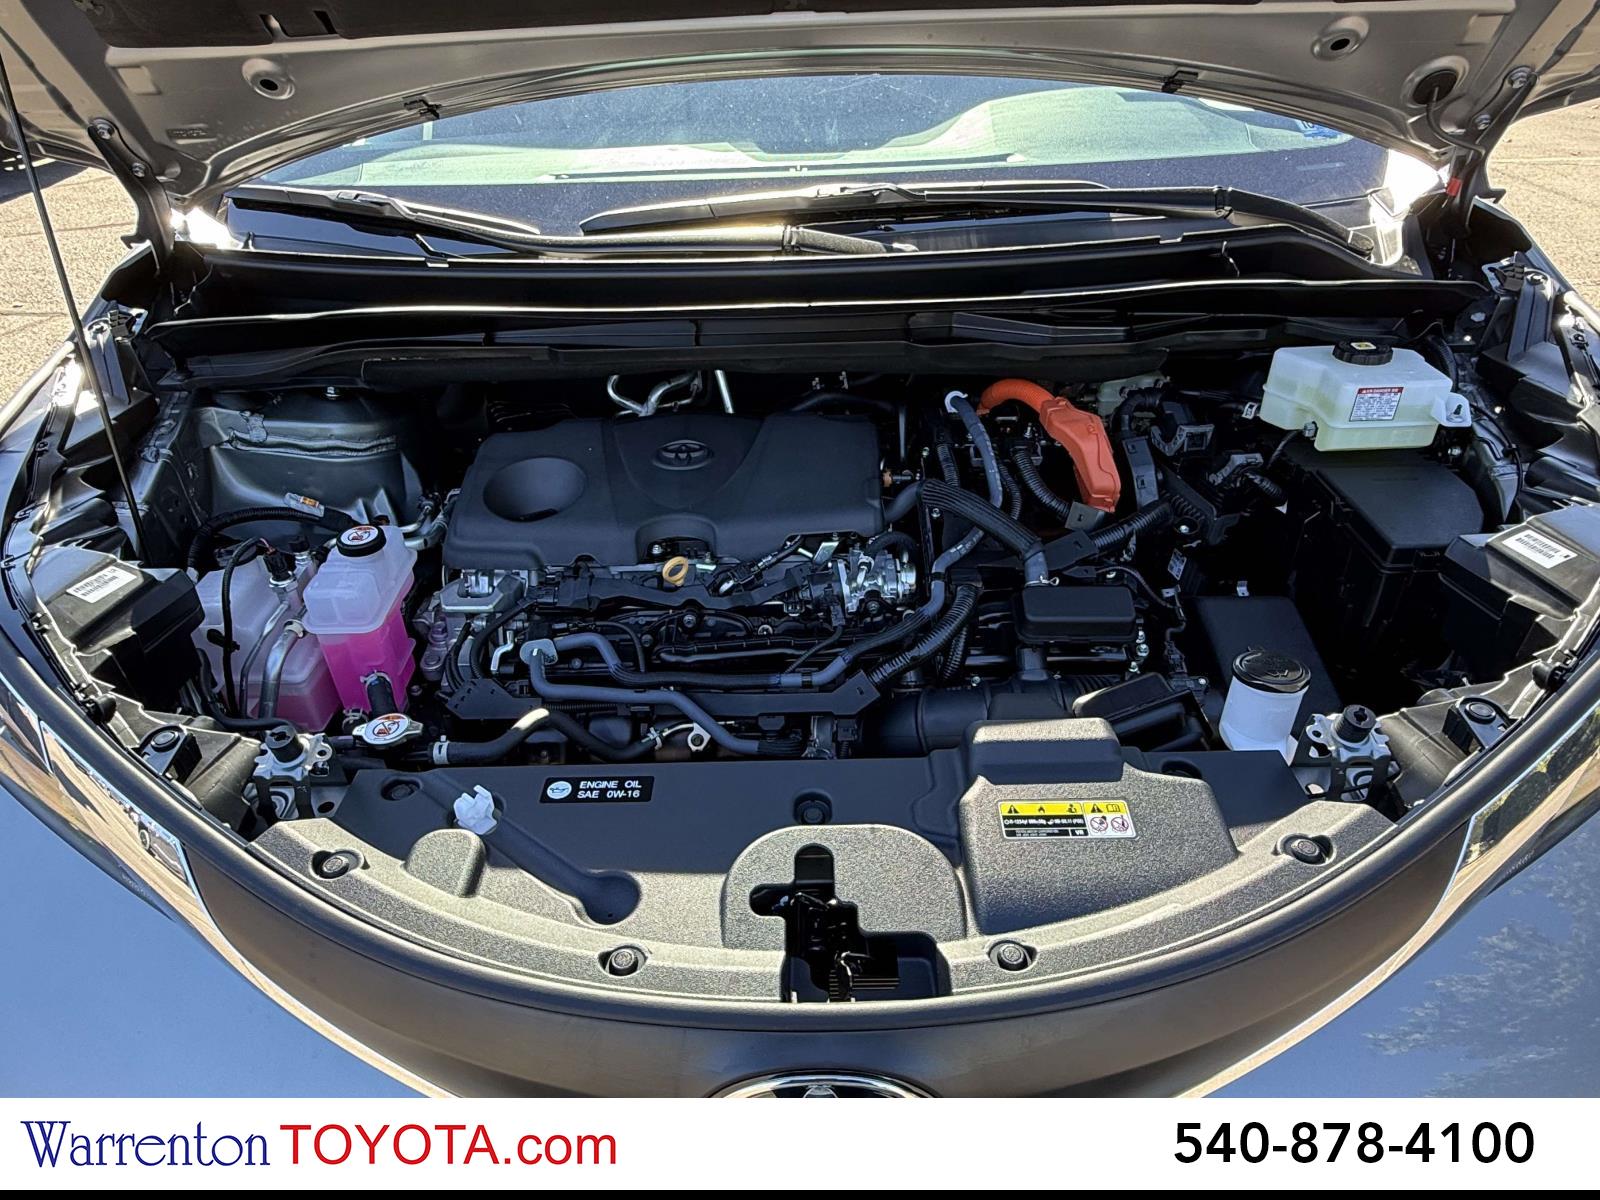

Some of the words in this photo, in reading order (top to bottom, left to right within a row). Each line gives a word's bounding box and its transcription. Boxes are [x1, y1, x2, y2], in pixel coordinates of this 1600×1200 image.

[579, 780, 619, 789] ENGINE
[624, 779, 642, 789] OIL
[576, 790, 600, 799] SAE
[606, 790, 641, 799] 0W-16
